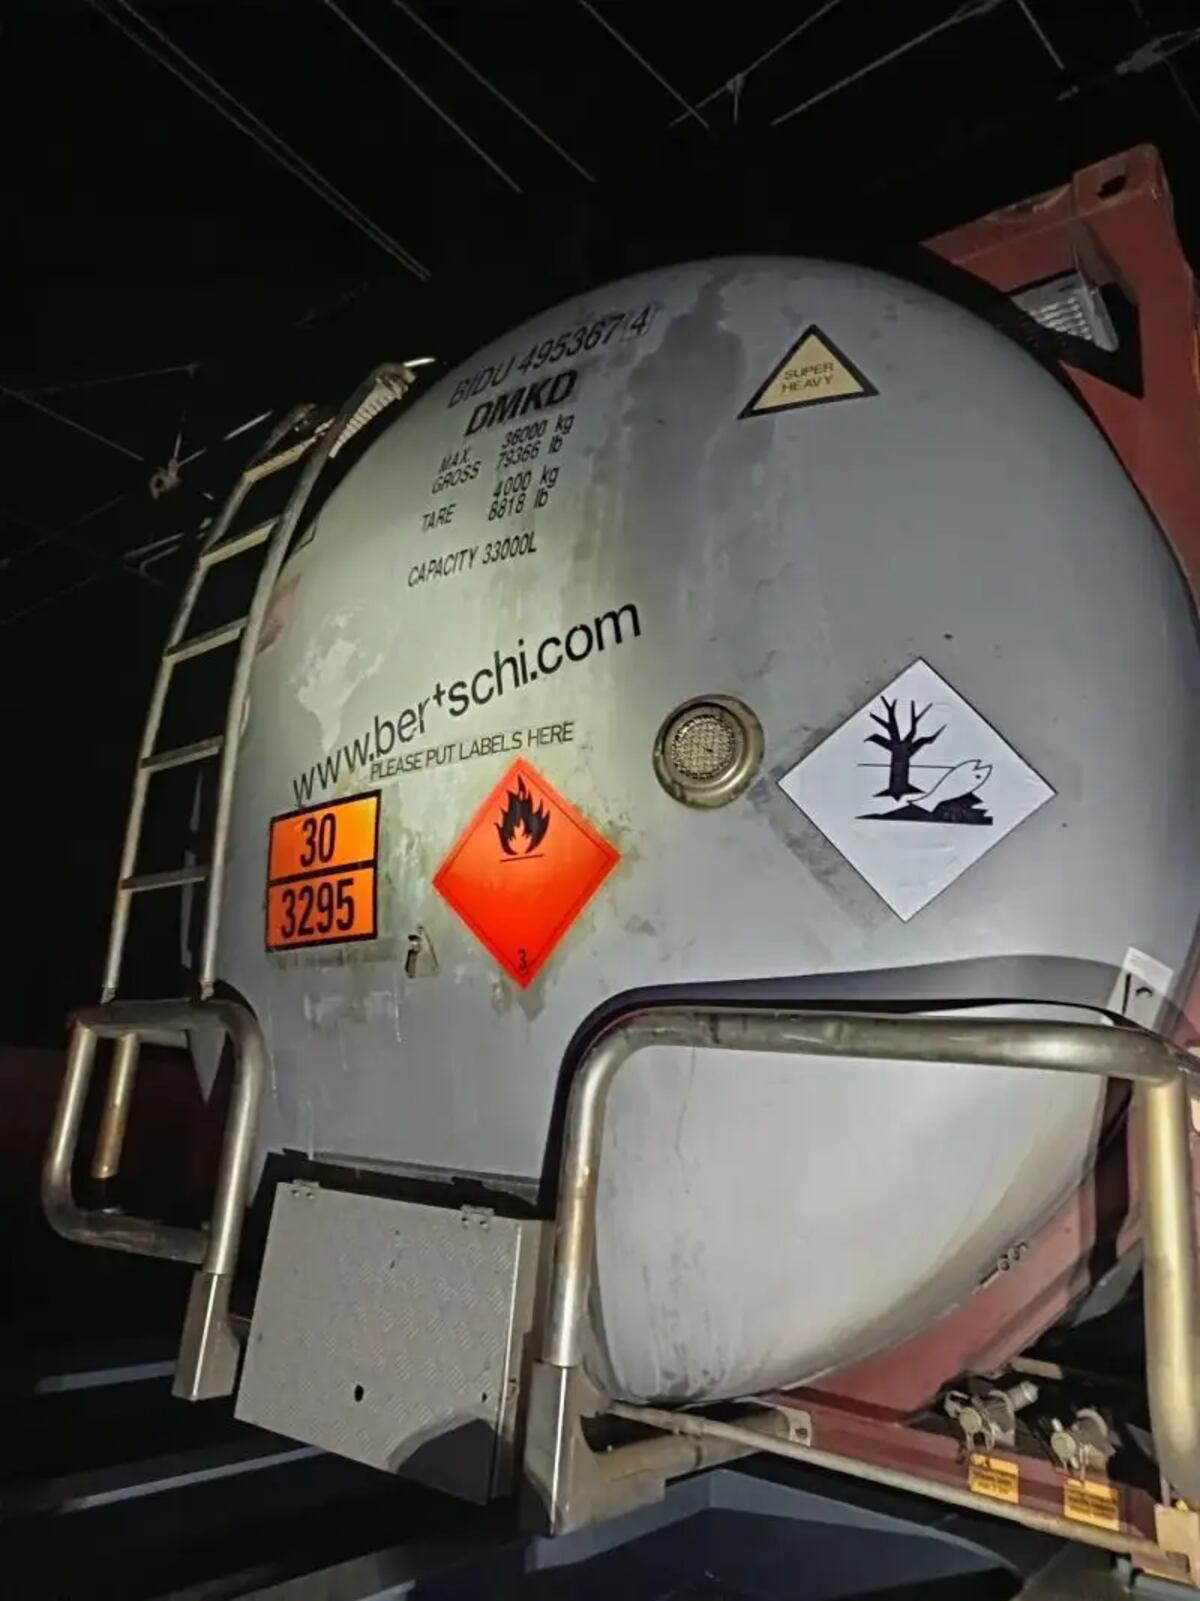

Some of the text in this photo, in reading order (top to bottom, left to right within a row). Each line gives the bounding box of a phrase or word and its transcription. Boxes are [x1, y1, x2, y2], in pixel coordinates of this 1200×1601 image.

[448, 357, 515, 409] BIDU
[517, 313, 625, 374] 495367
[784, 362, 834, 380] SUPER
[781, 374, 834, 394] HEAVY
[464, 371, 578, 437] DMKD
[554, 413, 575, 435] kg
[547, 434, 563, 455] lb
[432, 460, 481, 494] GROSS
[493, 465, 560, 497] 4000 kg
[421, 503, 457, 532] TARE
[487, 490, 549, 522] 8818 lb
[407, 530, 537, 587] CAPACITY 33000L
[370, 720, 575, 782] PLEASE PUT LABELS HERE
[301, 812, 336, 867] 30
[281, 878, 355, 939] 3295
[517, 949, 529, 972] 3
